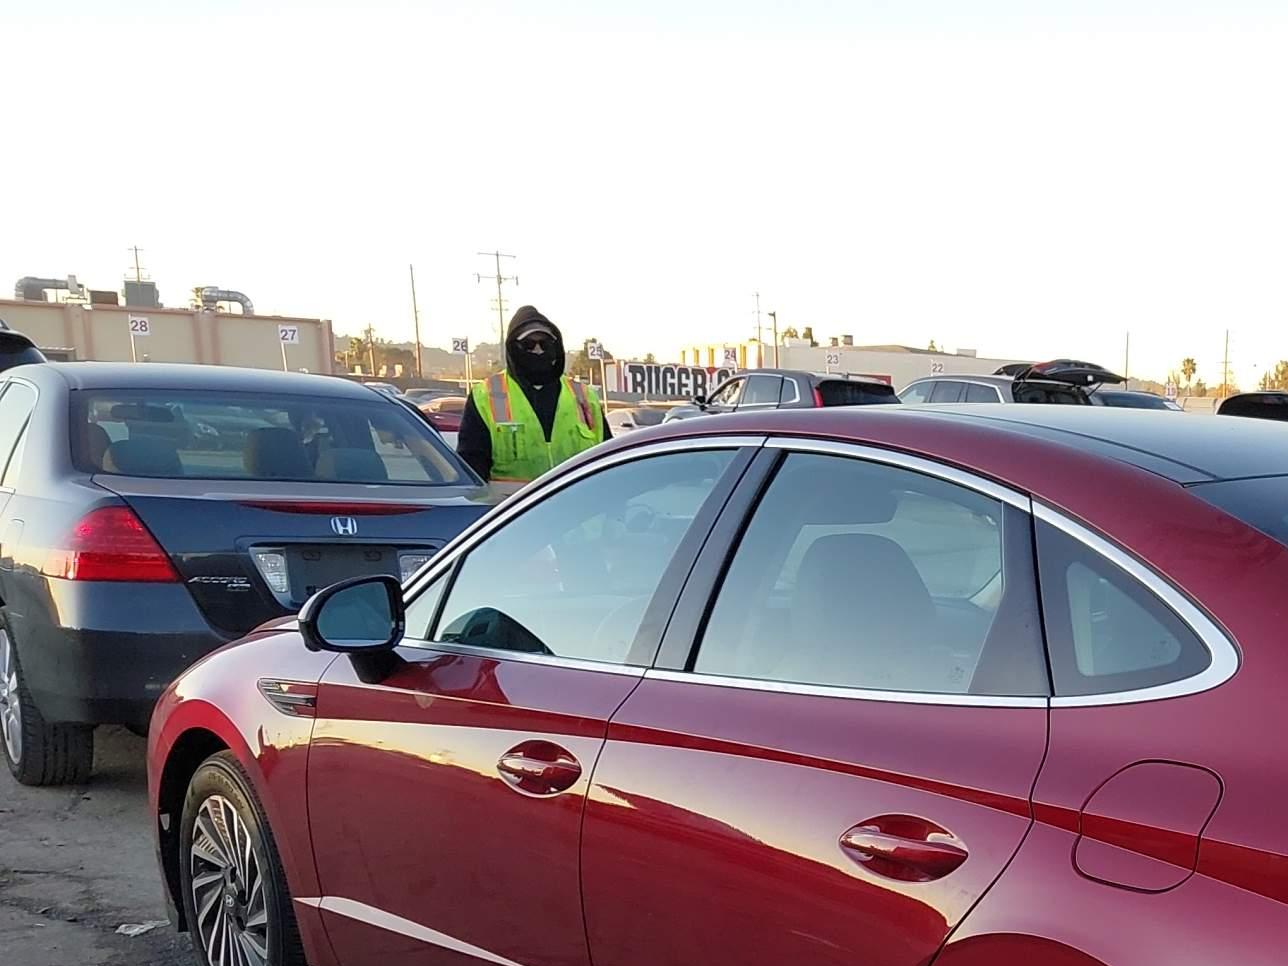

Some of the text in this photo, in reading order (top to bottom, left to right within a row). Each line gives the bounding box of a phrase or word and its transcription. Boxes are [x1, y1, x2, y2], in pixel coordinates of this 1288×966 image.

[130, 320, 148, 332] 28
[280, 329, 297, 341] 27
[589, 345, 602, 356] 25
[724, 350, 736, 359] 24
[826, 354, 839, 364] 23
[931, 363, 944, 373] 22
